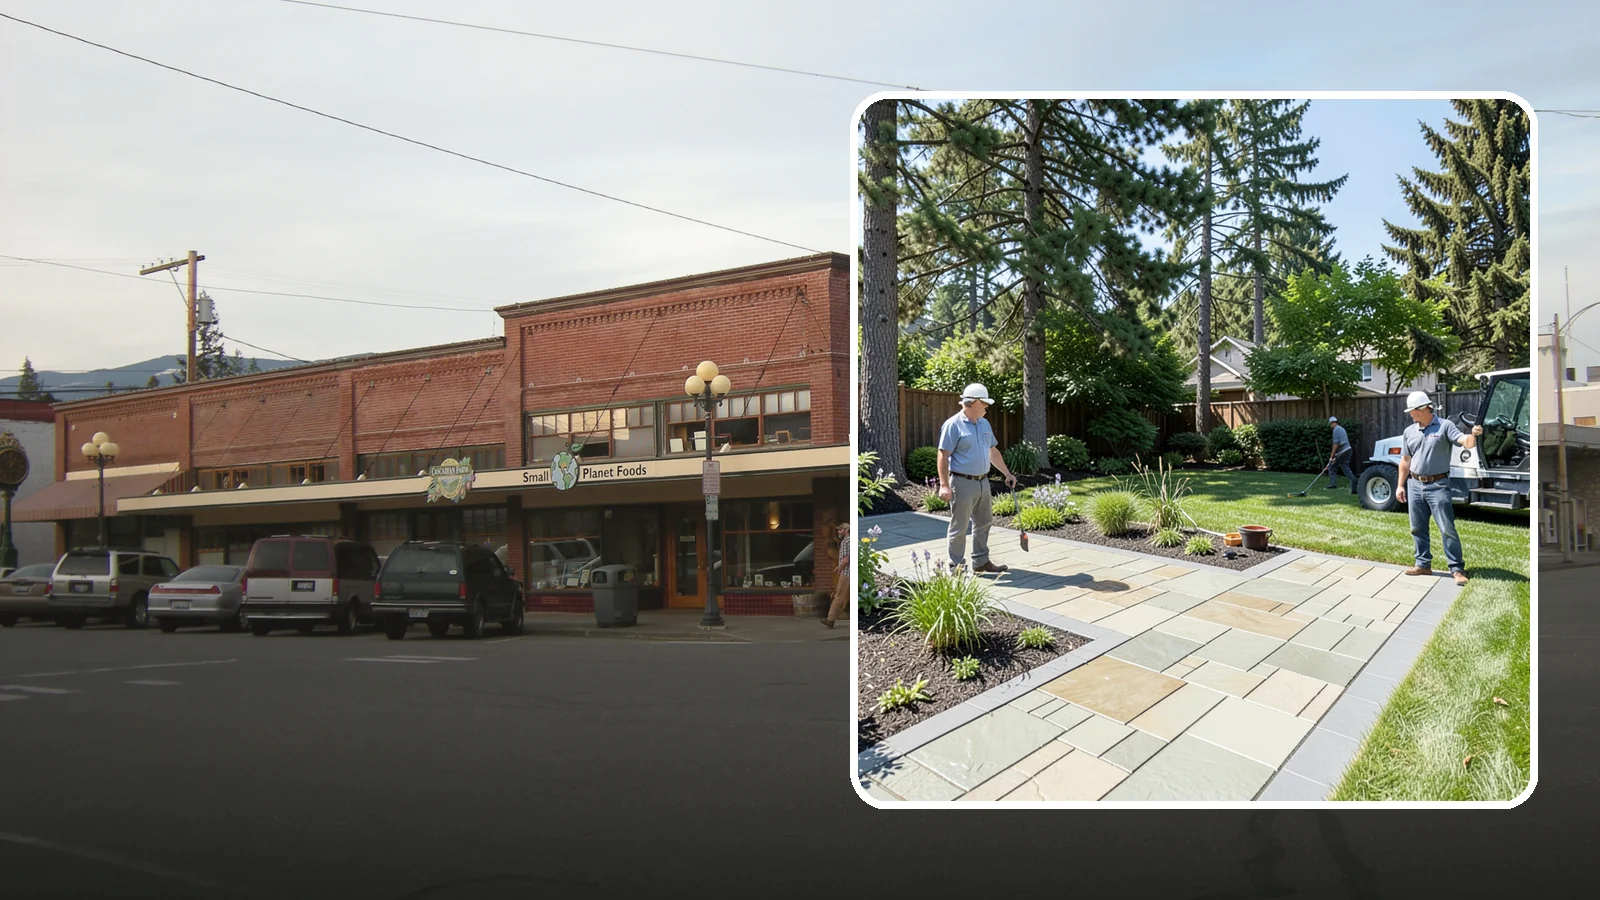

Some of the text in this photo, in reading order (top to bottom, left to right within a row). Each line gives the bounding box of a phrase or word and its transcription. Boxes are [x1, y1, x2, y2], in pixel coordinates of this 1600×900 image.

[523, 464, 647, 483] Small Planet Foods
